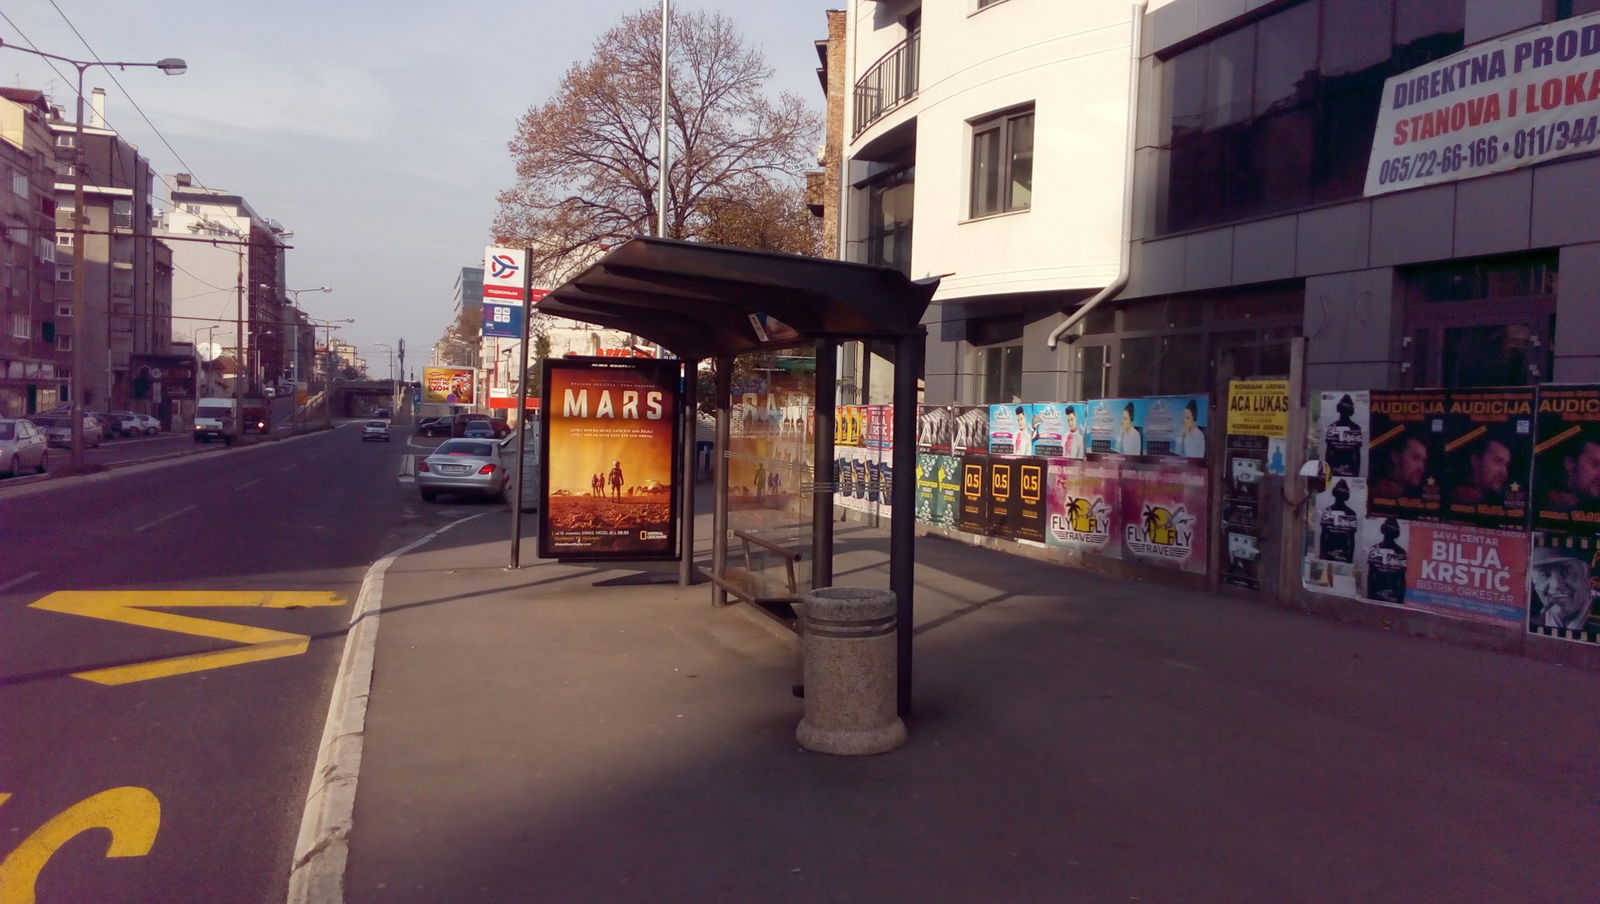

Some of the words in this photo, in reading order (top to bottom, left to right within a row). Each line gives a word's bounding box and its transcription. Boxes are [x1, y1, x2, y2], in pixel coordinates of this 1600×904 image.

[1392, 49, 1507, 110] DIREKTNA
[1393, 92, 1501, 147] STANOVA
[1508, 88, 1518, 118] I
[1379, 135, 1498, 186] 065/22-66-166
[563, 388, 663, 420] MARS
[1231, 395, 1251, 412] ACA
[1253, 395, 1289, 412] LUKAS
[1371, 401, 1445, 415] AUDICIJA
[1449, 401, 1532, 415] AUDICIJA
[966, 473, 979, 488] 0.5
[994, 473, 1008, 489] 0.5
[1023, 474, 1038, 491] 0.5
[1052, 515, 1072, 530] FLY
[1088, 518, 1109, 534] FLY
[1127, 525, 1149, 542] FLY
[1167, 529, 1192, 547] FLY
[1433, 531, 1458, 543] SAVA
[1461, 534, 1499, 546] CENTAR
[1432, 540, 1501, 569] BILJA
[1421, 559, 1511, 592] KRSTIĆ
[1416, 580, 1454, 594] BISTRIK
[1457, 587, 1514, 604] ORKESTAR
